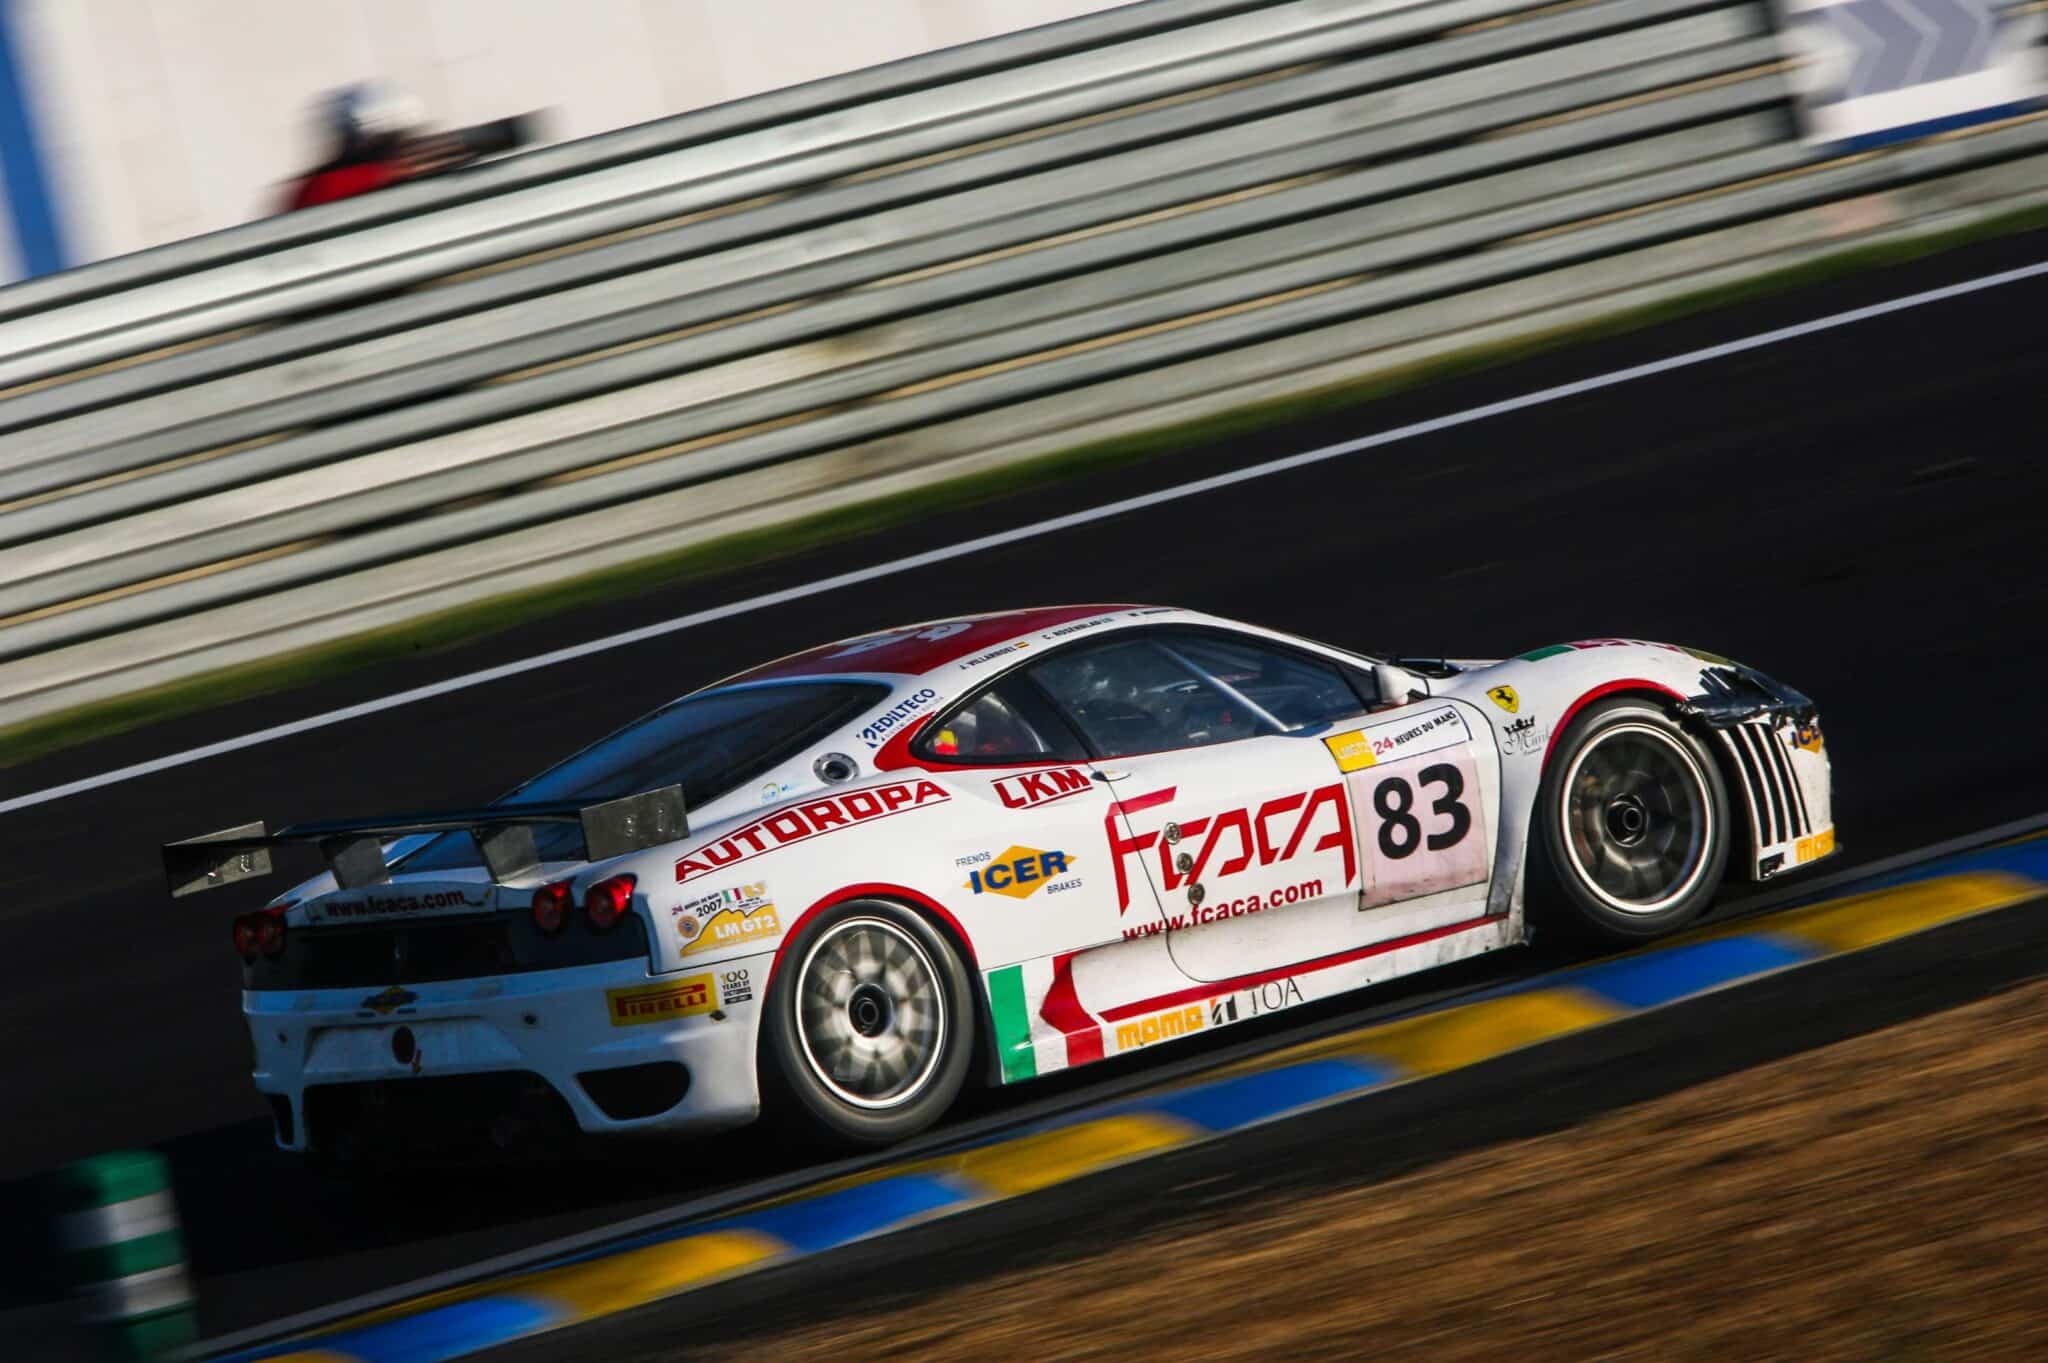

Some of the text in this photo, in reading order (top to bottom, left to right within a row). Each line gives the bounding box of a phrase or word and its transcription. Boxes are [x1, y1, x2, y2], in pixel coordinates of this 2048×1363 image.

[1372, 736, 1394, 756] 24
[1394, 726, 1424, 746] HEURES
[1420, 721, 1435, 733] DU
[1434, 710, 1457, 727] MANS
[993, 768, 1091, 809] LKM
[675, 780, 950, 882] AUTOROPA
[1373, 763, 1471, 859] 83
[954, 851, 992, 867] FRENOS
[969, 850, 1069, 895] ICER
[1046, 878, 1083, 895] BRAKES
[696, 898, 723, 918] 2007
[1122, 878, 1323, 942] www.fcaca.com
[615, 983, 708, 1018] PIRELLI
[1244, 976, 1305, 1016] TOA
